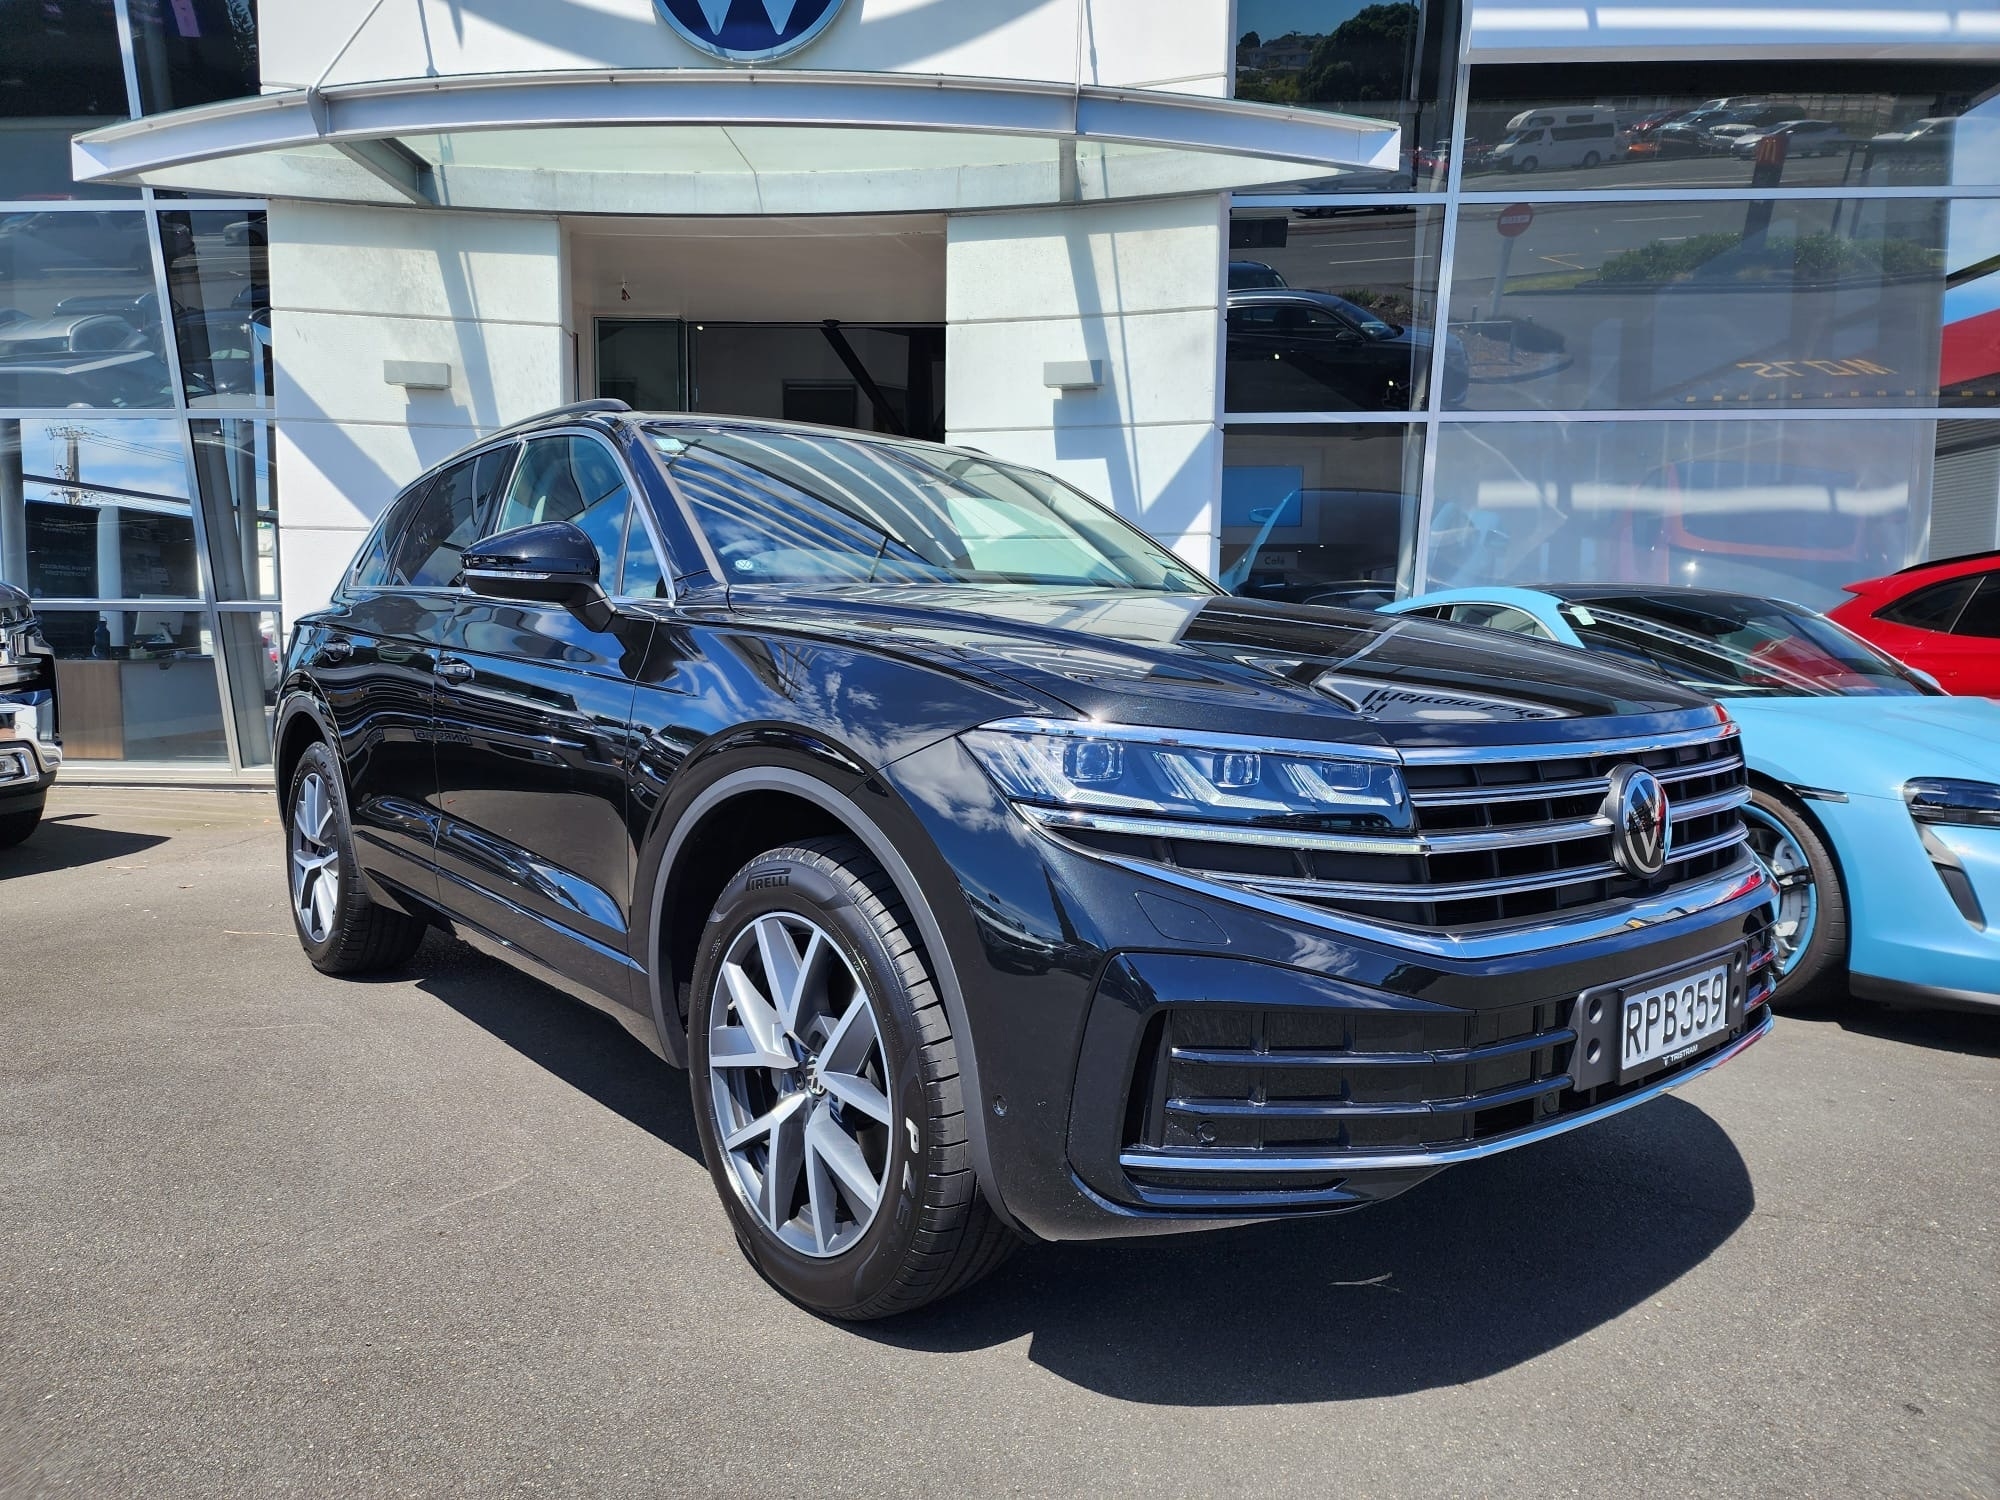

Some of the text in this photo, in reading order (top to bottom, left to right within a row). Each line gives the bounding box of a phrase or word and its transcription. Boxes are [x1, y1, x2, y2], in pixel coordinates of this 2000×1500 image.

[745, 868, 792, 892] PIRELLI
[1625, 972, 1724, 1059] RPB359
[1669, 1043, 1699, 1062] TRISTRAM
